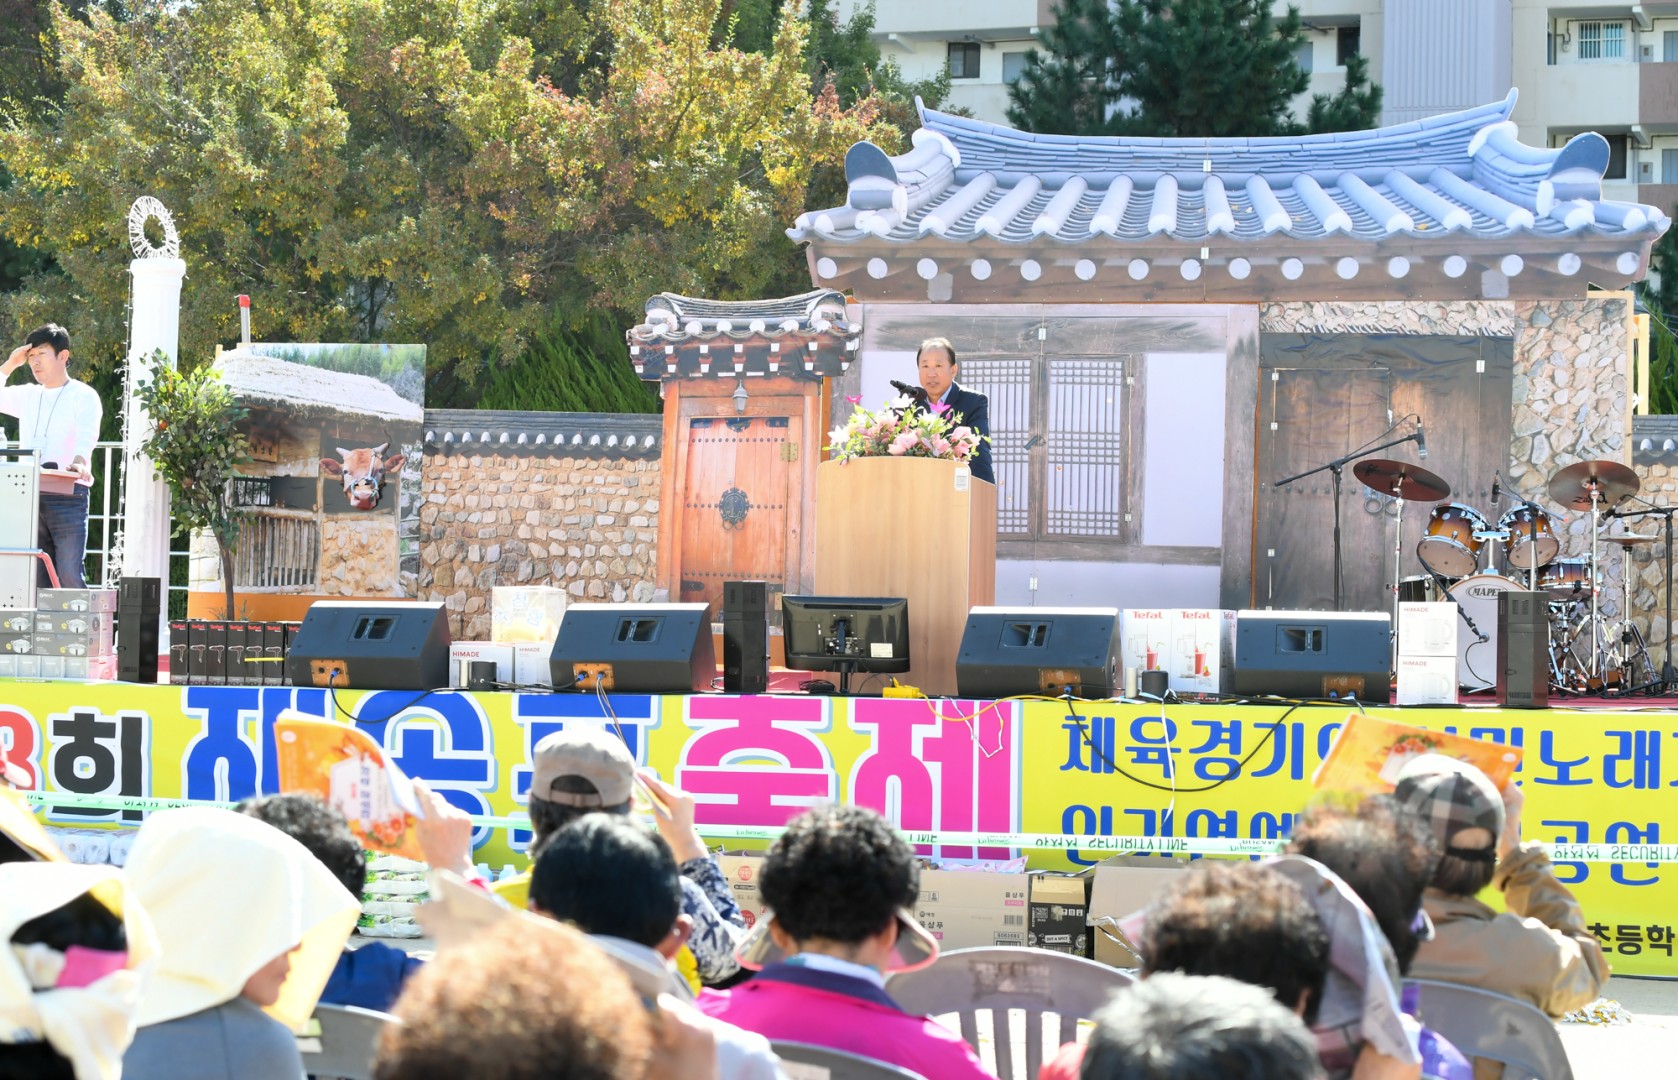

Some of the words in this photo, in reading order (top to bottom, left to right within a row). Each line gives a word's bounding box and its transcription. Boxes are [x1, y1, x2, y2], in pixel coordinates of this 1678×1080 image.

[1473, 588, 1501, 597] MAPE
[1132, 611, 1163, 619] Tefal
[1181, 611, 1211, 619] Tefal
